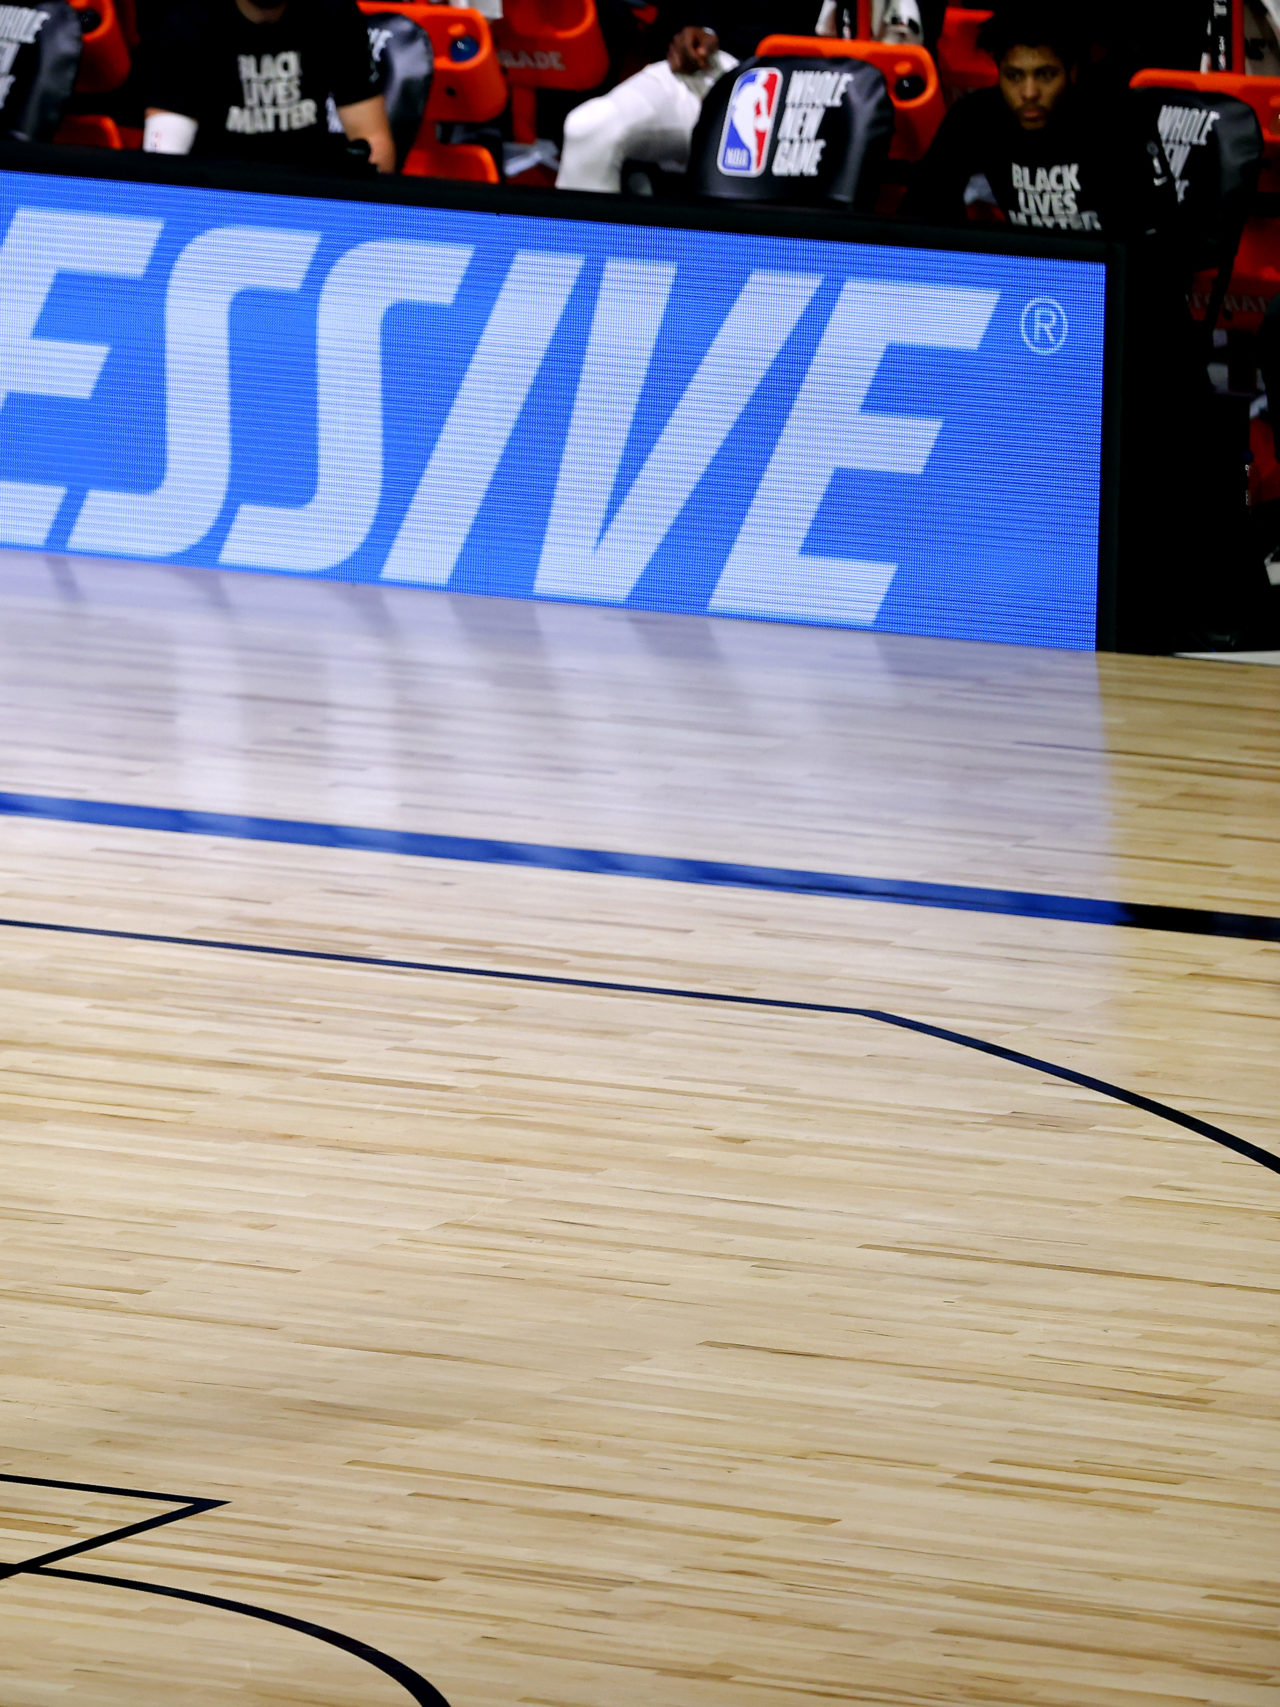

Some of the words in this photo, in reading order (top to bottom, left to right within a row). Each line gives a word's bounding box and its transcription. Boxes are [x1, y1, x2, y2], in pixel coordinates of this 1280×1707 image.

[242, 78, 302, 107] LIVES
[786, 70, 854, 107] WHOLE
[225, 98, 318, 135] MATTER
[777, 106, 826, 140] NEW
[1011, 163, 1081, 192] BLACK
[1017, 190, 1078, 216] LIVES
